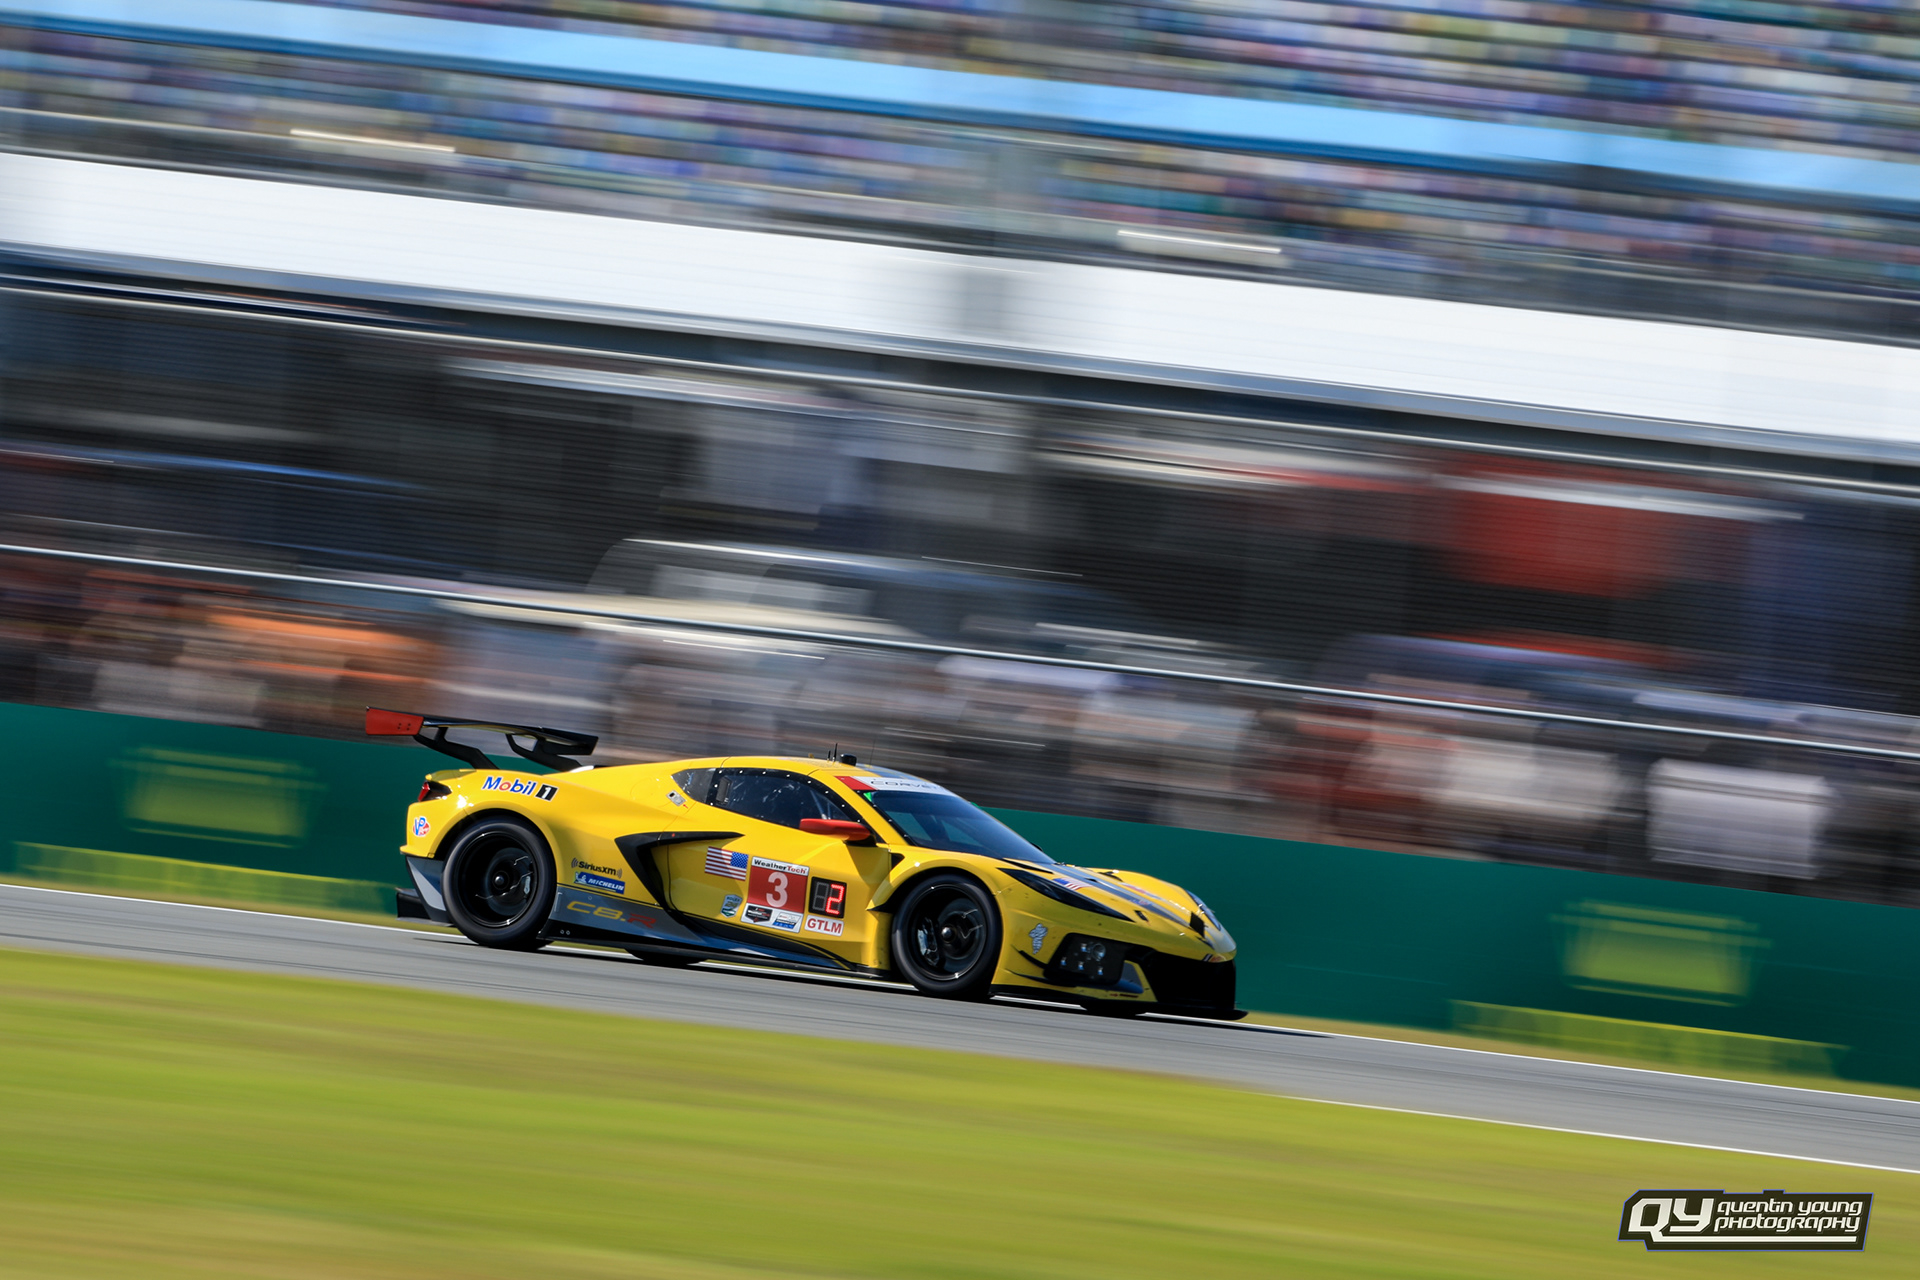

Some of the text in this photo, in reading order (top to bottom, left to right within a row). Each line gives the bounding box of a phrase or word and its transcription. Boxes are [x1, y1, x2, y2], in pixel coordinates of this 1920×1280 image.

[482, 776, 553, 799] Mobil 1
[754, 859, 807, 874] WeatherTech
[588, 878, 625, 891] MICHELIN
[766, 871, 788, 908] 3
[825, 883, 845, 915] 2
[807, 918, 842, 934] GTLM
